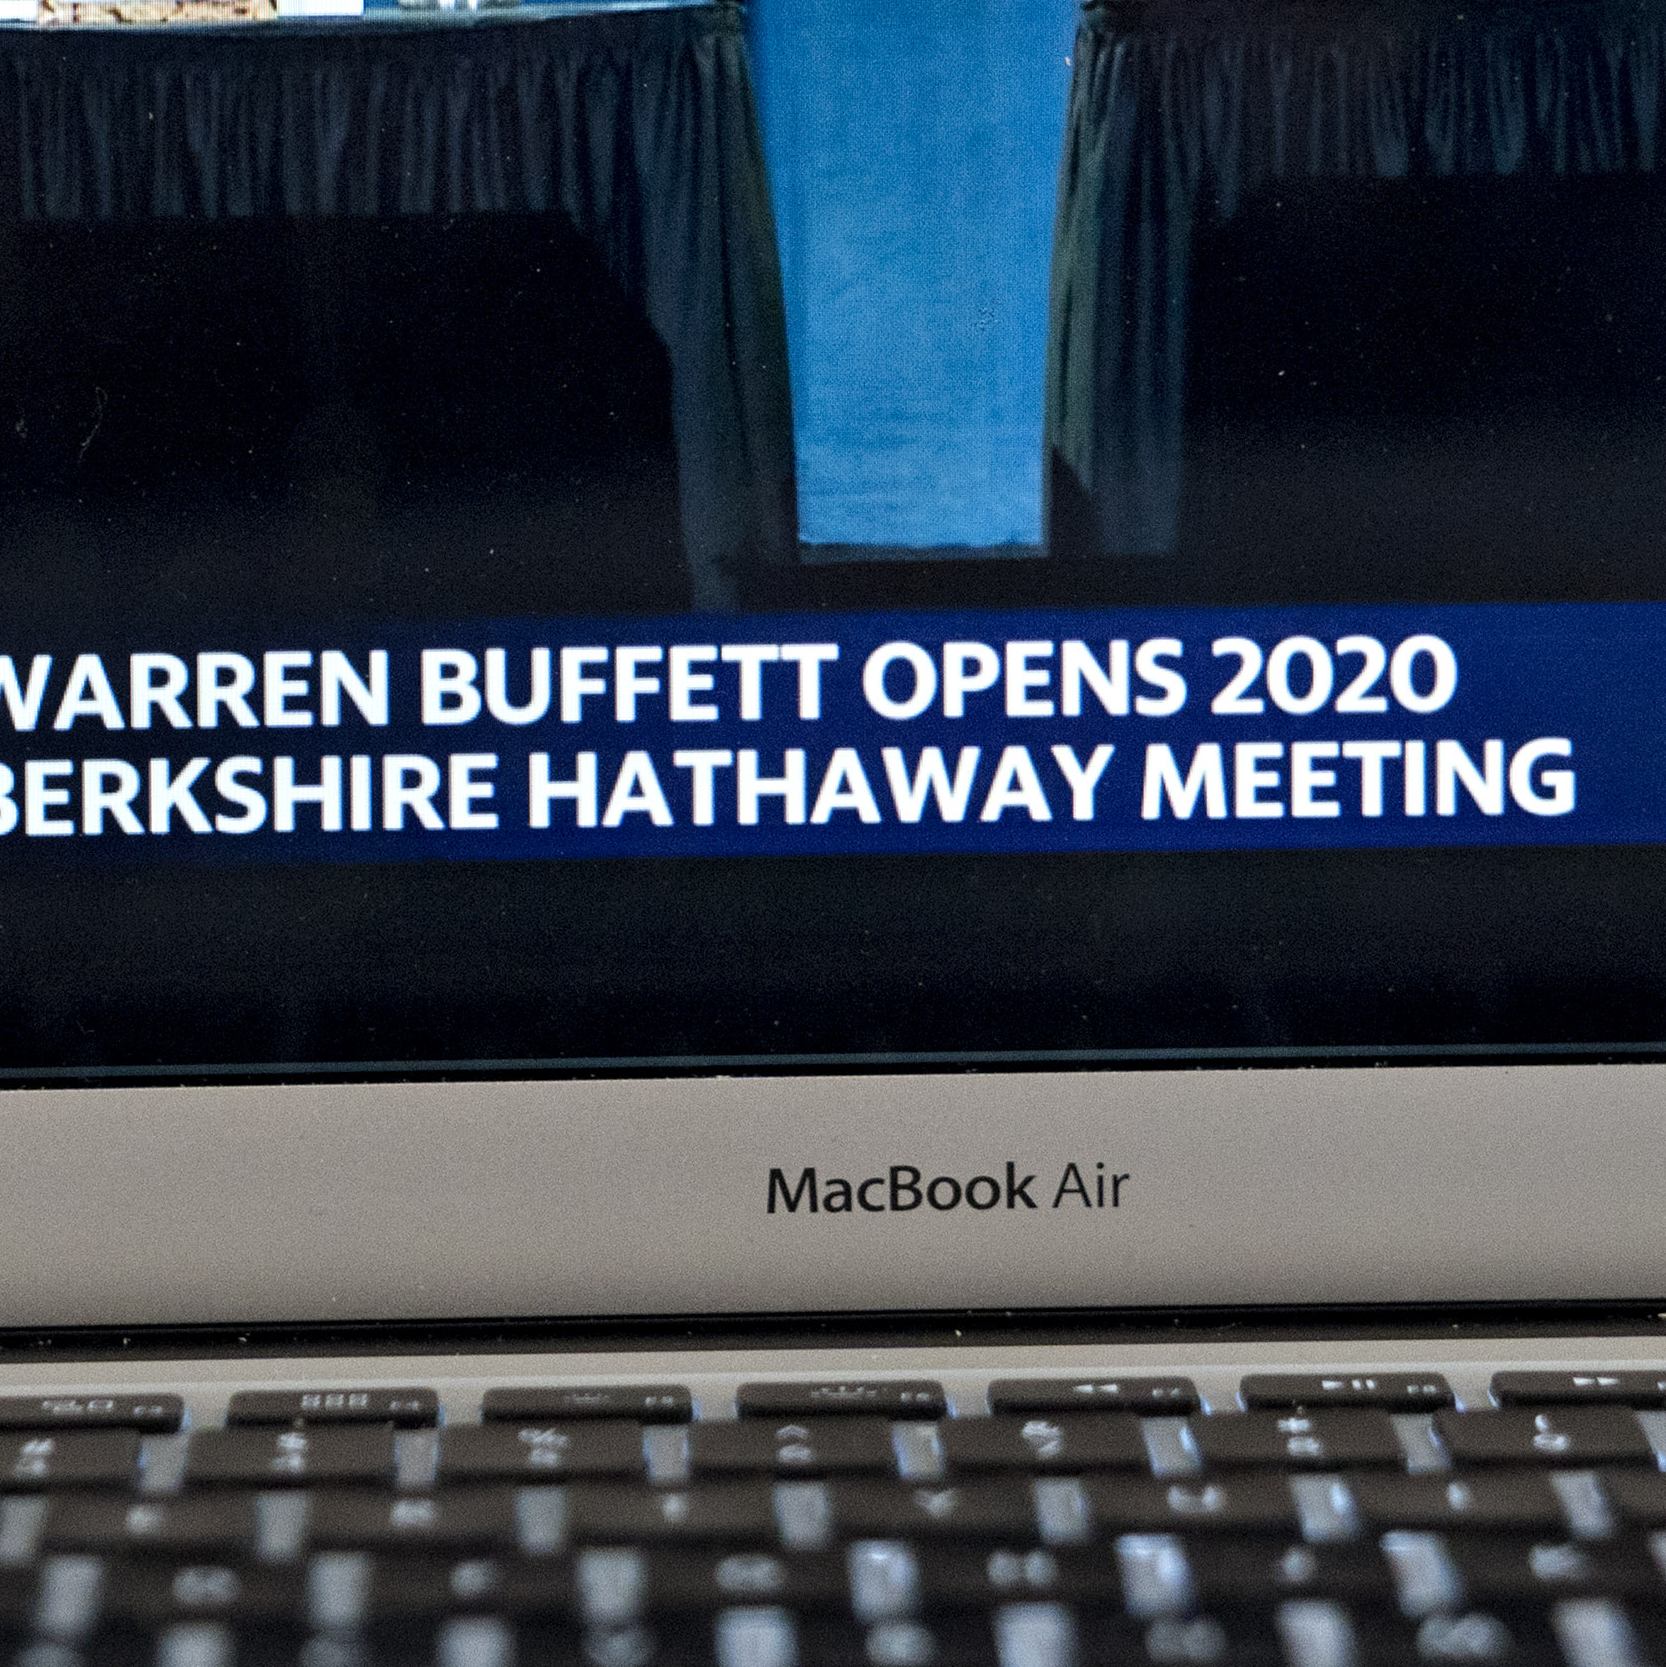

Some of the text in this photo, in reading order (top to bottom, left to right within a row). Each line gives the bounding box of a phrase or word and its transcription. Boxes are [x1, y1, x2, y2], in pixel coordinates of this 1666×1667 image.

[422, 643, 840, 725] BUFFETT
[862, 638, 1188, 720] OPENS
[1211, 635, 1458, 715] 2020
[529, 744, 1115, 829] HATHAWAY
[1141, 737, 1576, 820] MEETING
[767, 1161, 1131, 1215] MacBook Air
